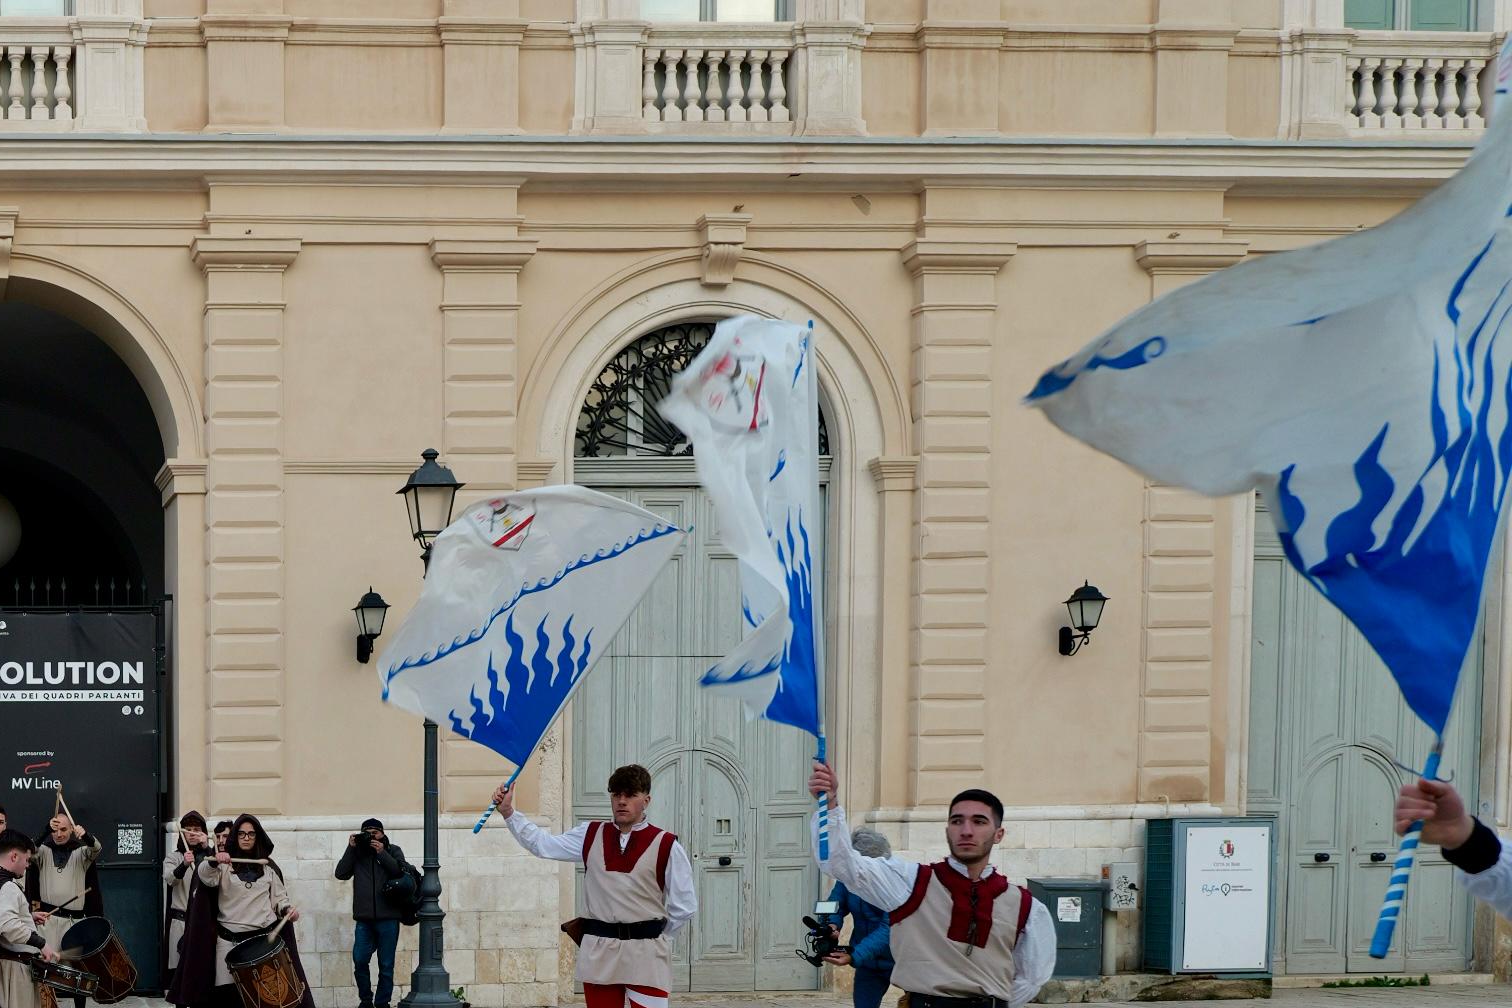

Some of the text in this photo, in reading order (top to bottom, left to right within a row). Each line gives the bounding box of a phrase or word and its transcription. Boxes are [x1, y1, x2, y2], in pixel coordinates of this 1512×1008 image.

[43, 692, 84, 700] QUADRI
[11, 776, 61, 790] MV Line
